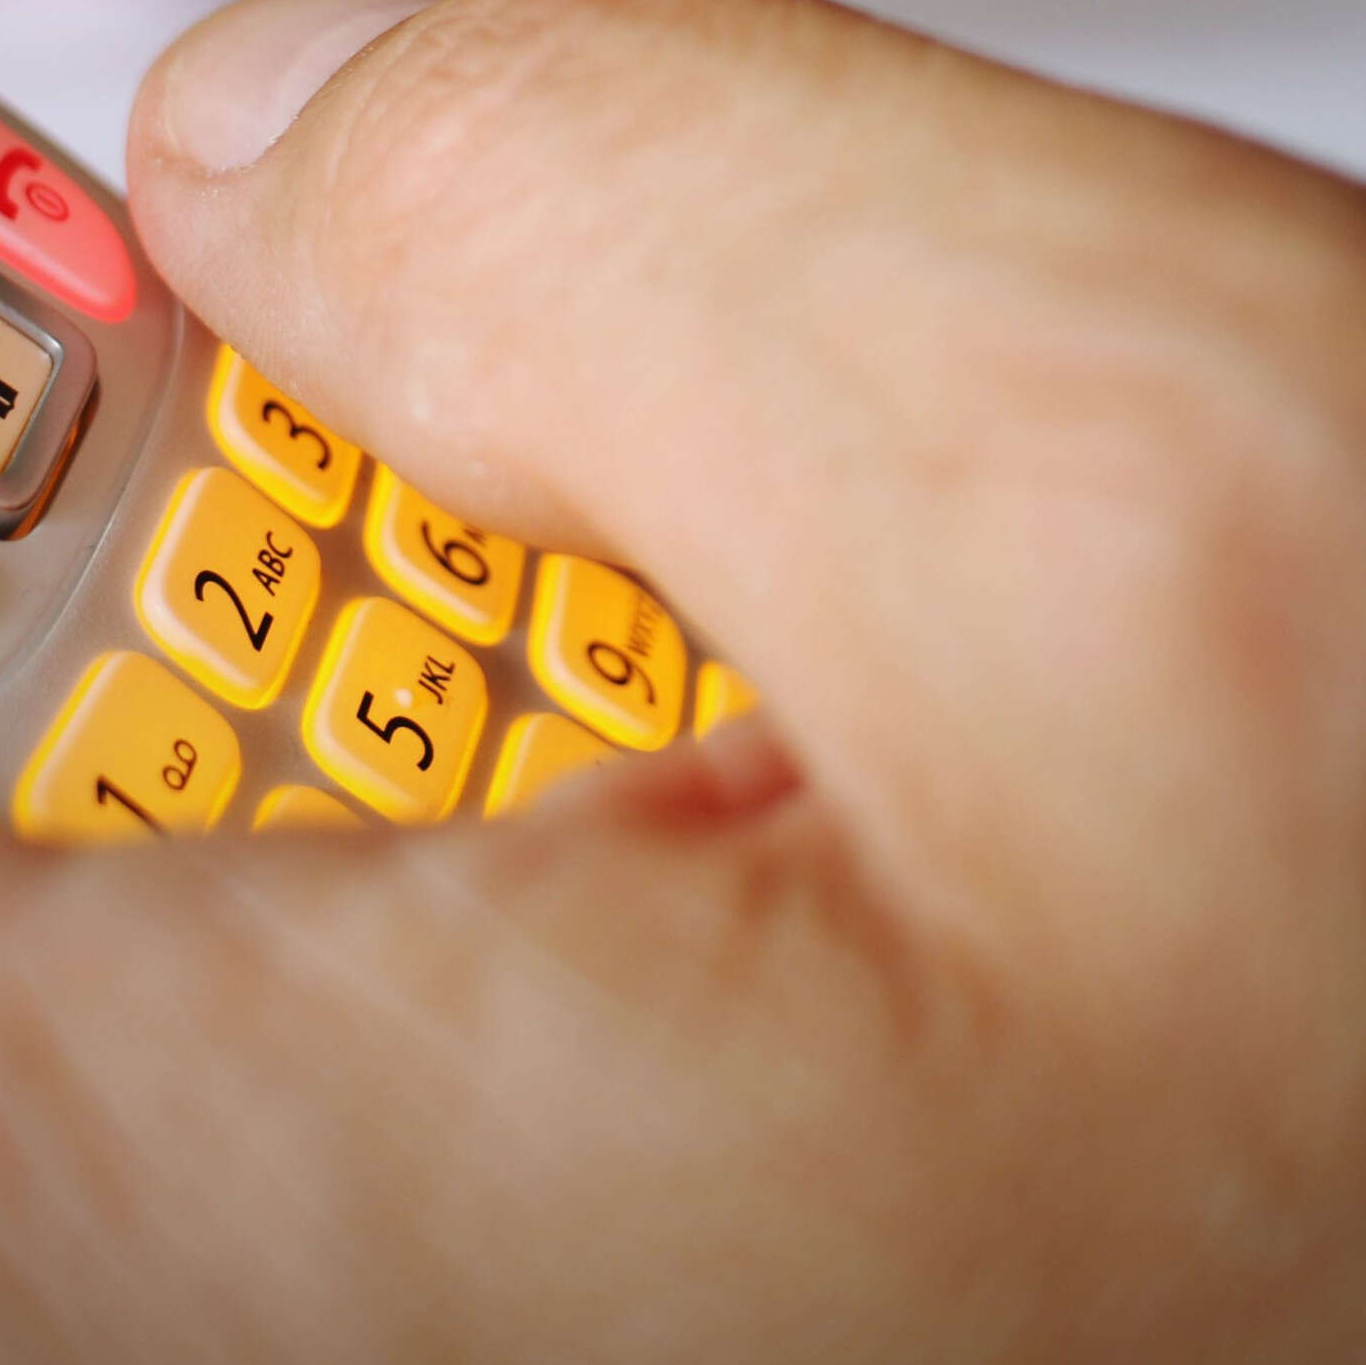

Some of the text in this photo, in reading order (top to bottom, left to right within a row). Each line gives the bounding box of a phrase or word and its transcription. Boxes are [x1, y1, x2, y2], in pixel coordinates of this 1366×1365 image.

[262, 400, 330, 470] 3
[420, 519, 489, 586] 6
[194, 530, 295, 653] 2 ABC
[587, 640, 656, 705] 9
[356, 655, 458, 772] 5 JKL
[95, 775, 169, 835] 1
